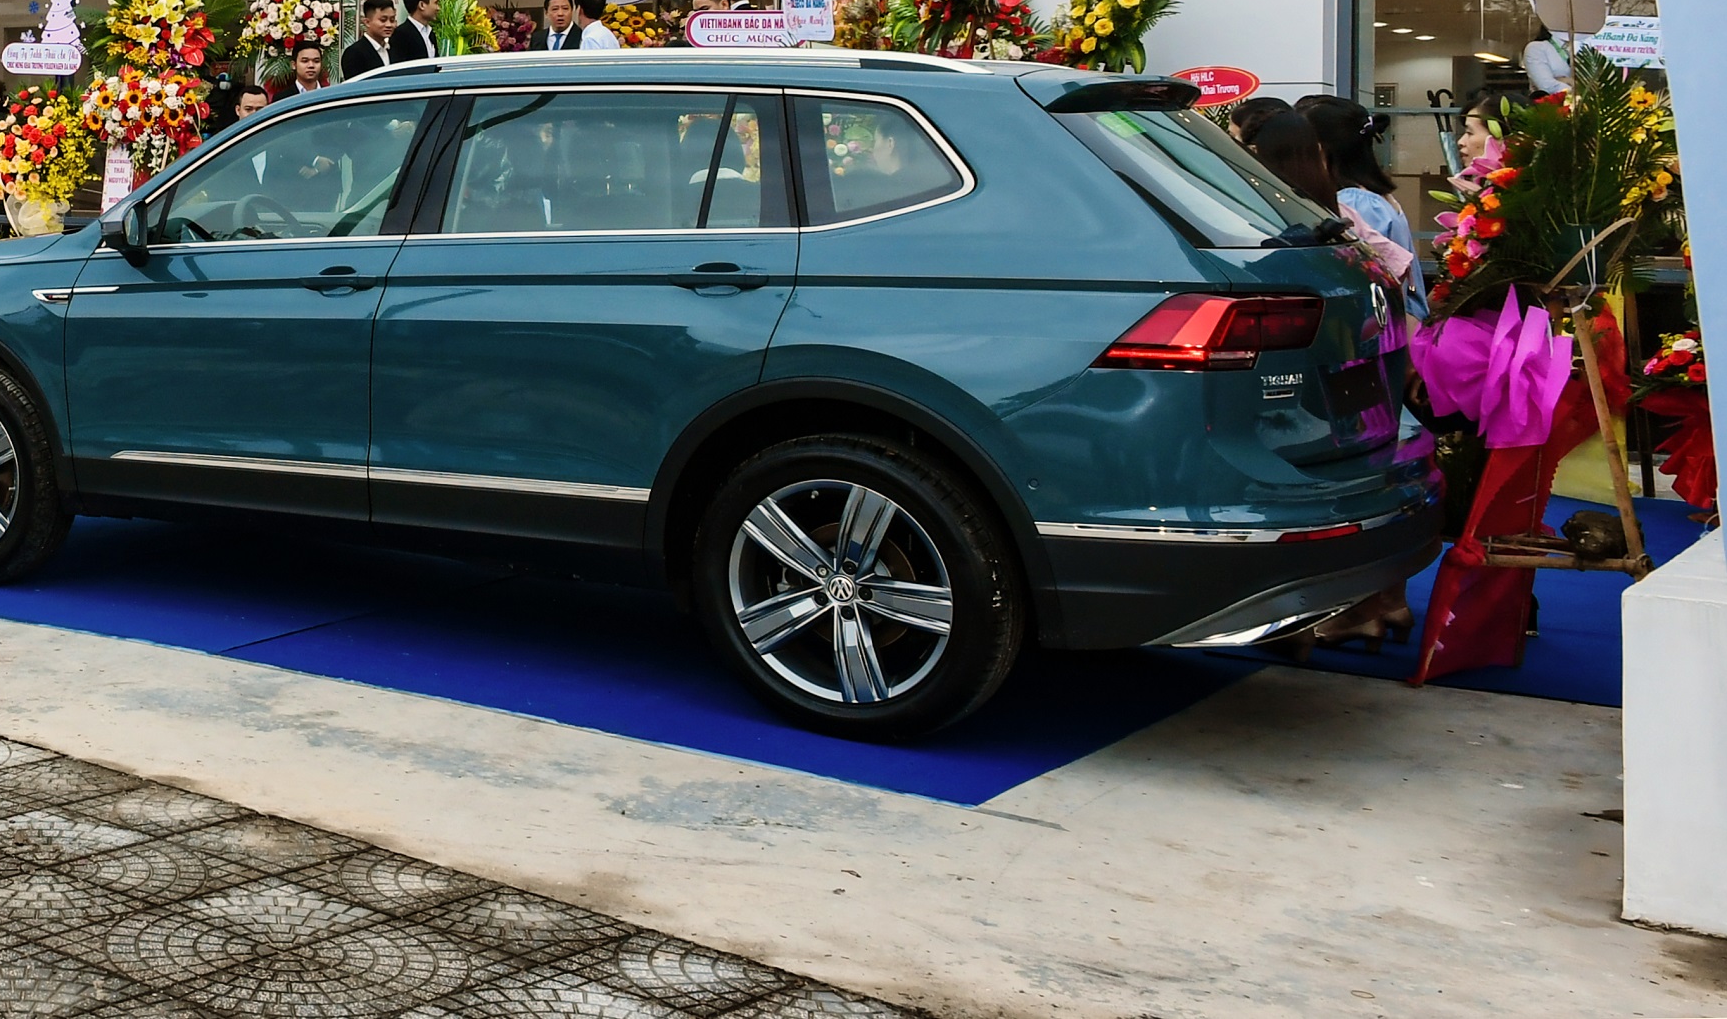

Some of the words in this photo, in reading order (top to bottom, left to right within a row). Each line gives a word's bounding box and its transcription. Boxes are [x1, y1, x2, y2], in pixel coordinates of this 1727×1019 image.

[700, 18, 742, 29] VIETINBANK
[707, 32, 739, 42] CHÚC
[1201, 72, 1214, 81] HLC
[1201, 85, 1215, 94] Khai
[1261, 373, 1303, 386] TIGUAN
